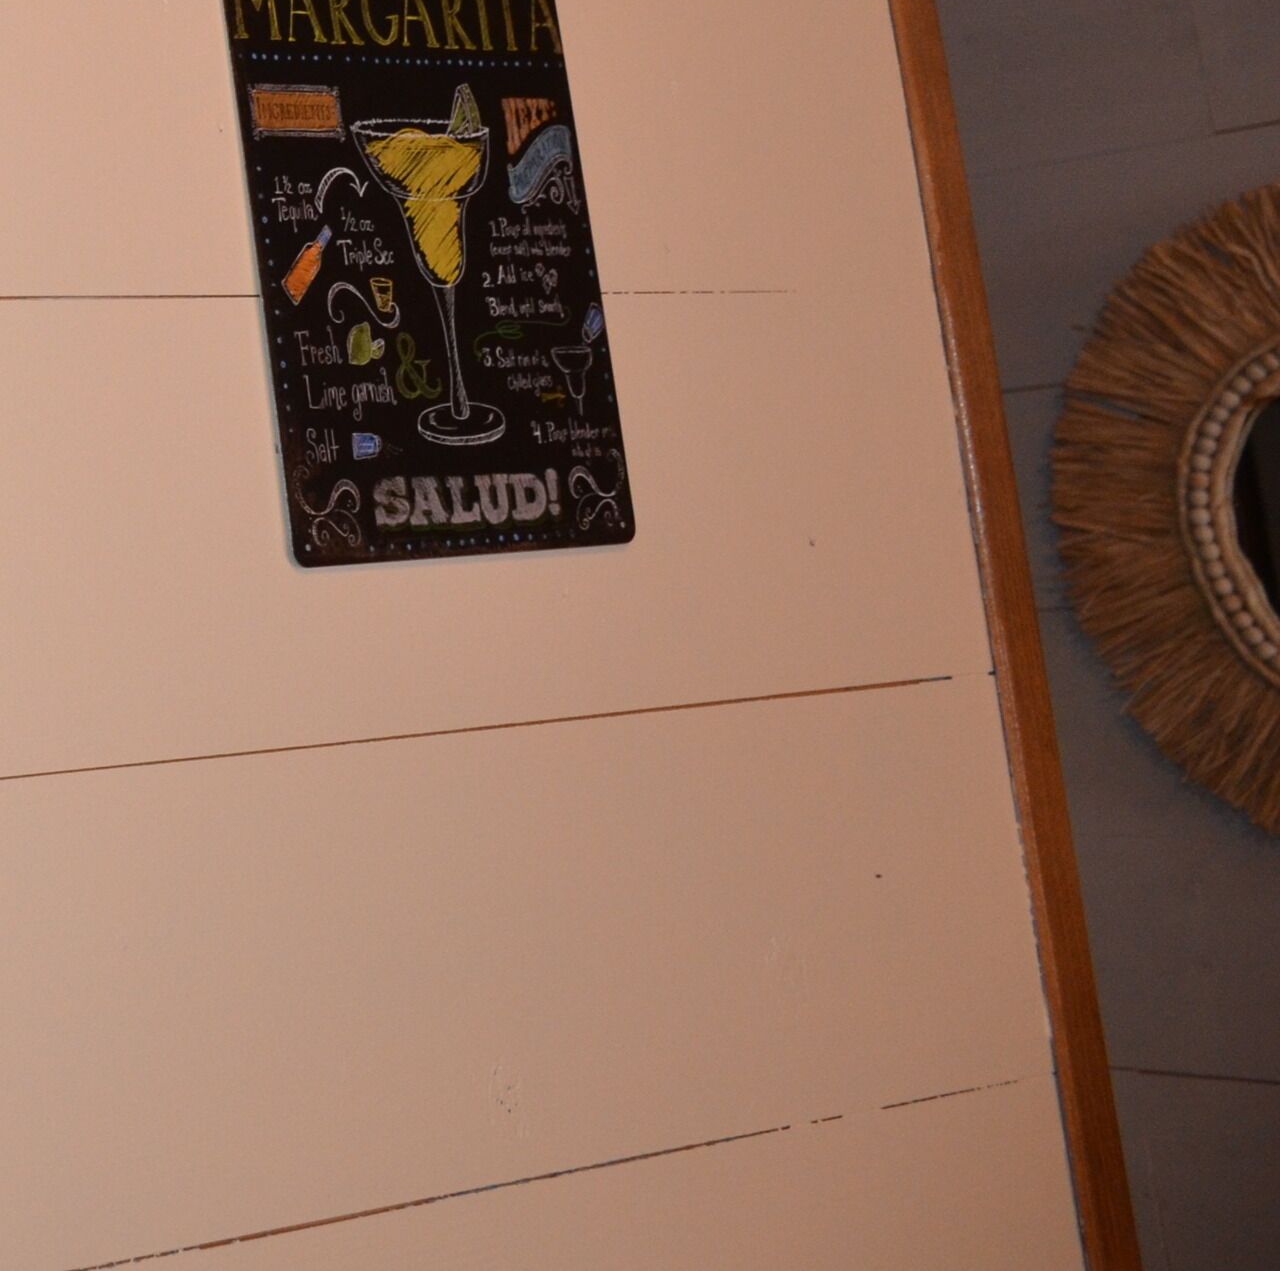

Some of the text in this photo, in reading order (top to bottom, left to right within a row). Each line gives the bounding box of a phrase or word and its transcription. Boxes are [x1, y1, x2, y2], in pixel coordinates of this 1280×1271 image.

[272, 197, 318, 233] Tequila
[337, 238, 395, 271] Triple Sec
[294, 326, 342, 367] Fresh
[304, 368, 397, 421] Lime garnish
[305, 428, 340, 465] Salt
[373, 468, 561, 527] SALUD!
